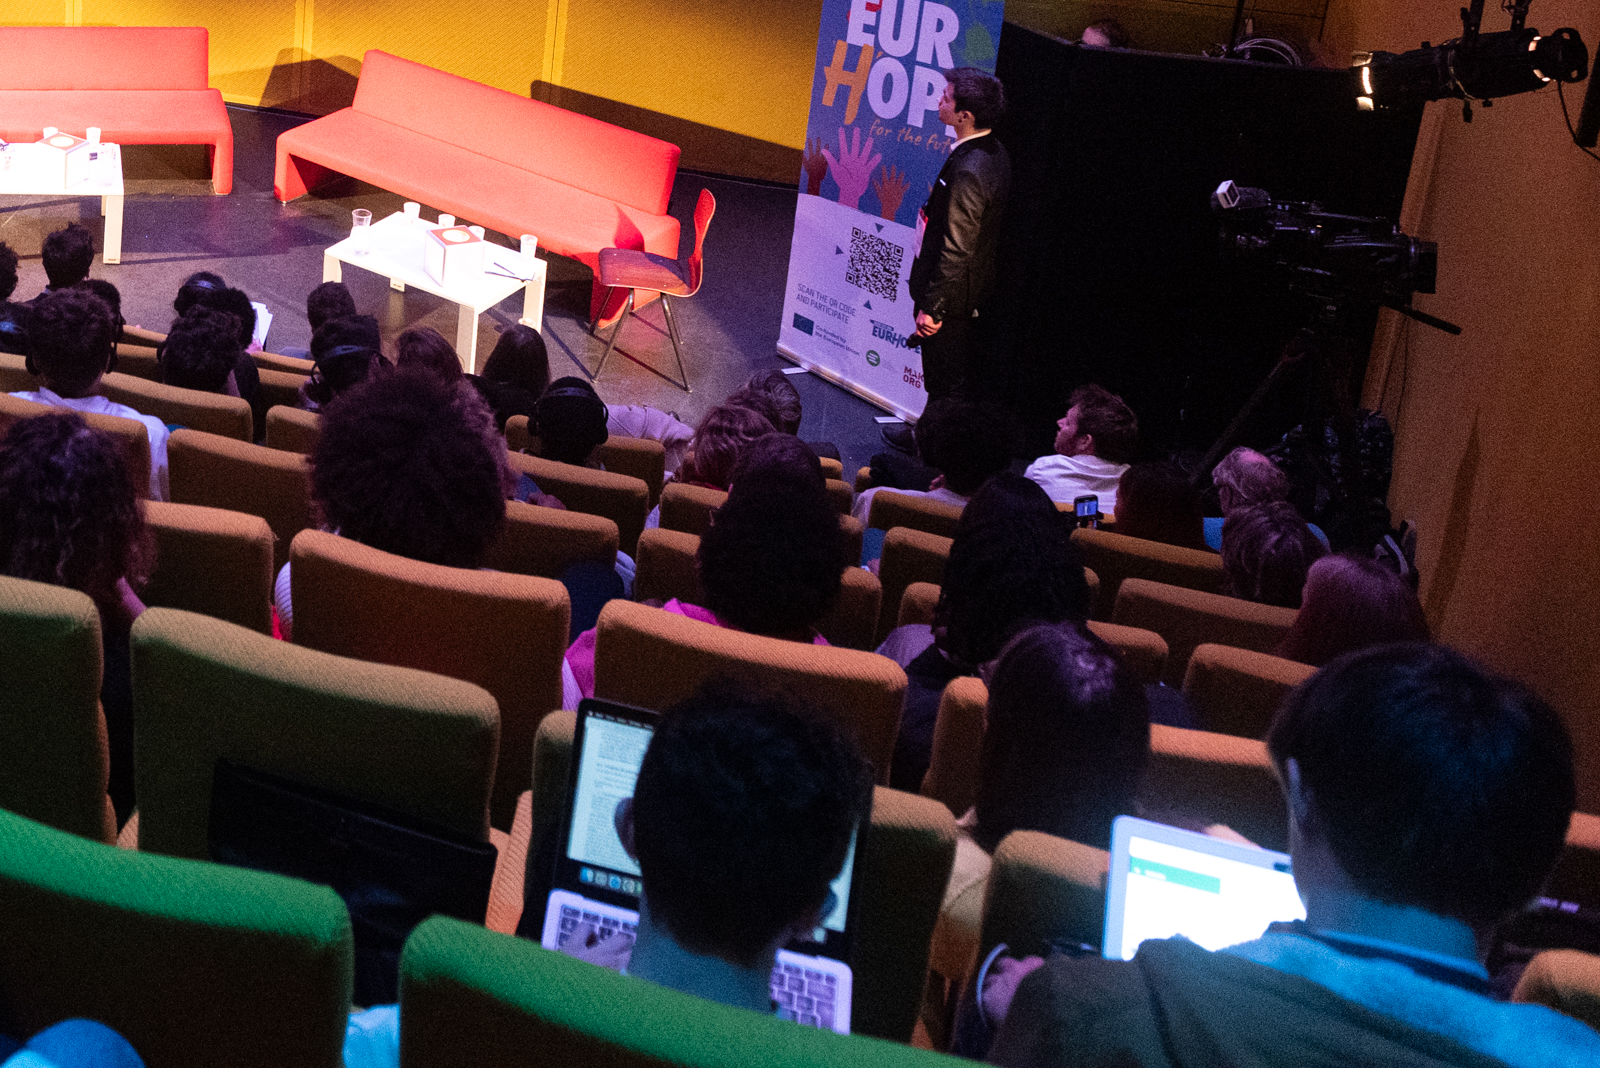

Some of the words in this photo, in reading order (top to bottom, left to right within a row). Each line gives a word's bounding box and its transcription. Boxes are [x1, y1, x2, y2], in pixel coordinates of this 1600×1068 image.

[821, 38, 957, 139] HOP
[869, 118, 892, 137] for
[897, 126, 923, 146] the
[796, 293, 810, 306] AND
[810, 300, 849, 324] PARTICIPATE
[797, 283, 814, 297] SCAN
[815, 290, 828, 304] THE
[839, 302, 856, 317] CODE
[903, 374, 921, 389] ORG
